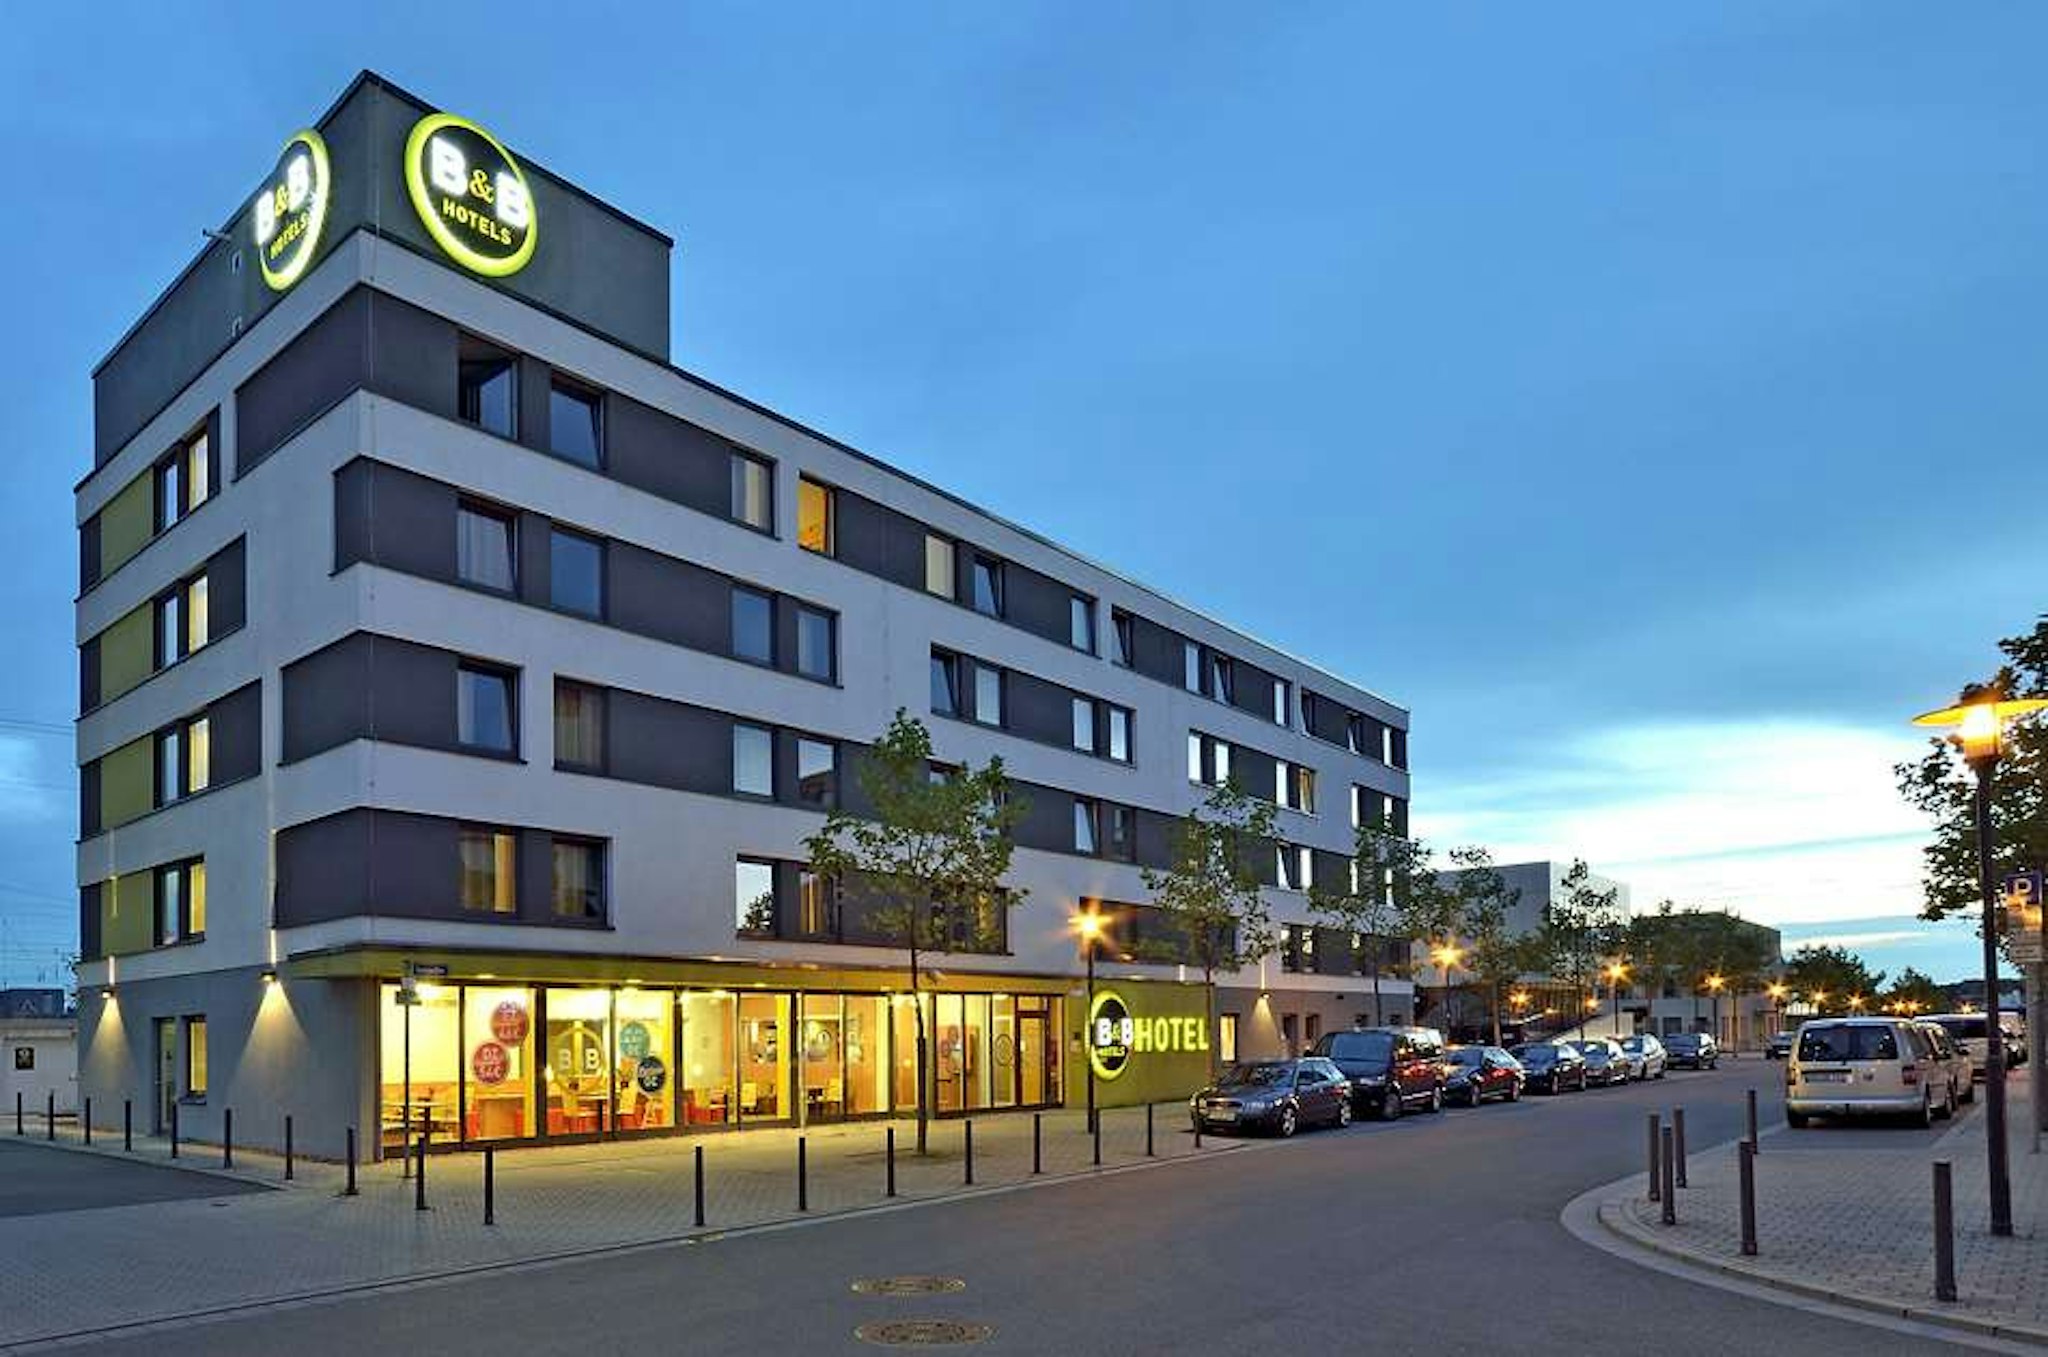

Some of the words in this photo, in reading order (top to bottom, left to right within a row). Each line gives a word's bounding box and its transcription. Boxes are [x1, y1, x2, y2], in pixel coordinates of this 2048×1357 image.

[256, 154, 309, 246] B&B
[433, 136, 530, 229] B&B
[269, 211, 309, 261] HOTELS
[442, 197, 512, 246] HOTELS
[1095, 1017, 1134, 1047] B&B
[1134, 1016, 1209, 1053] HOTEL
